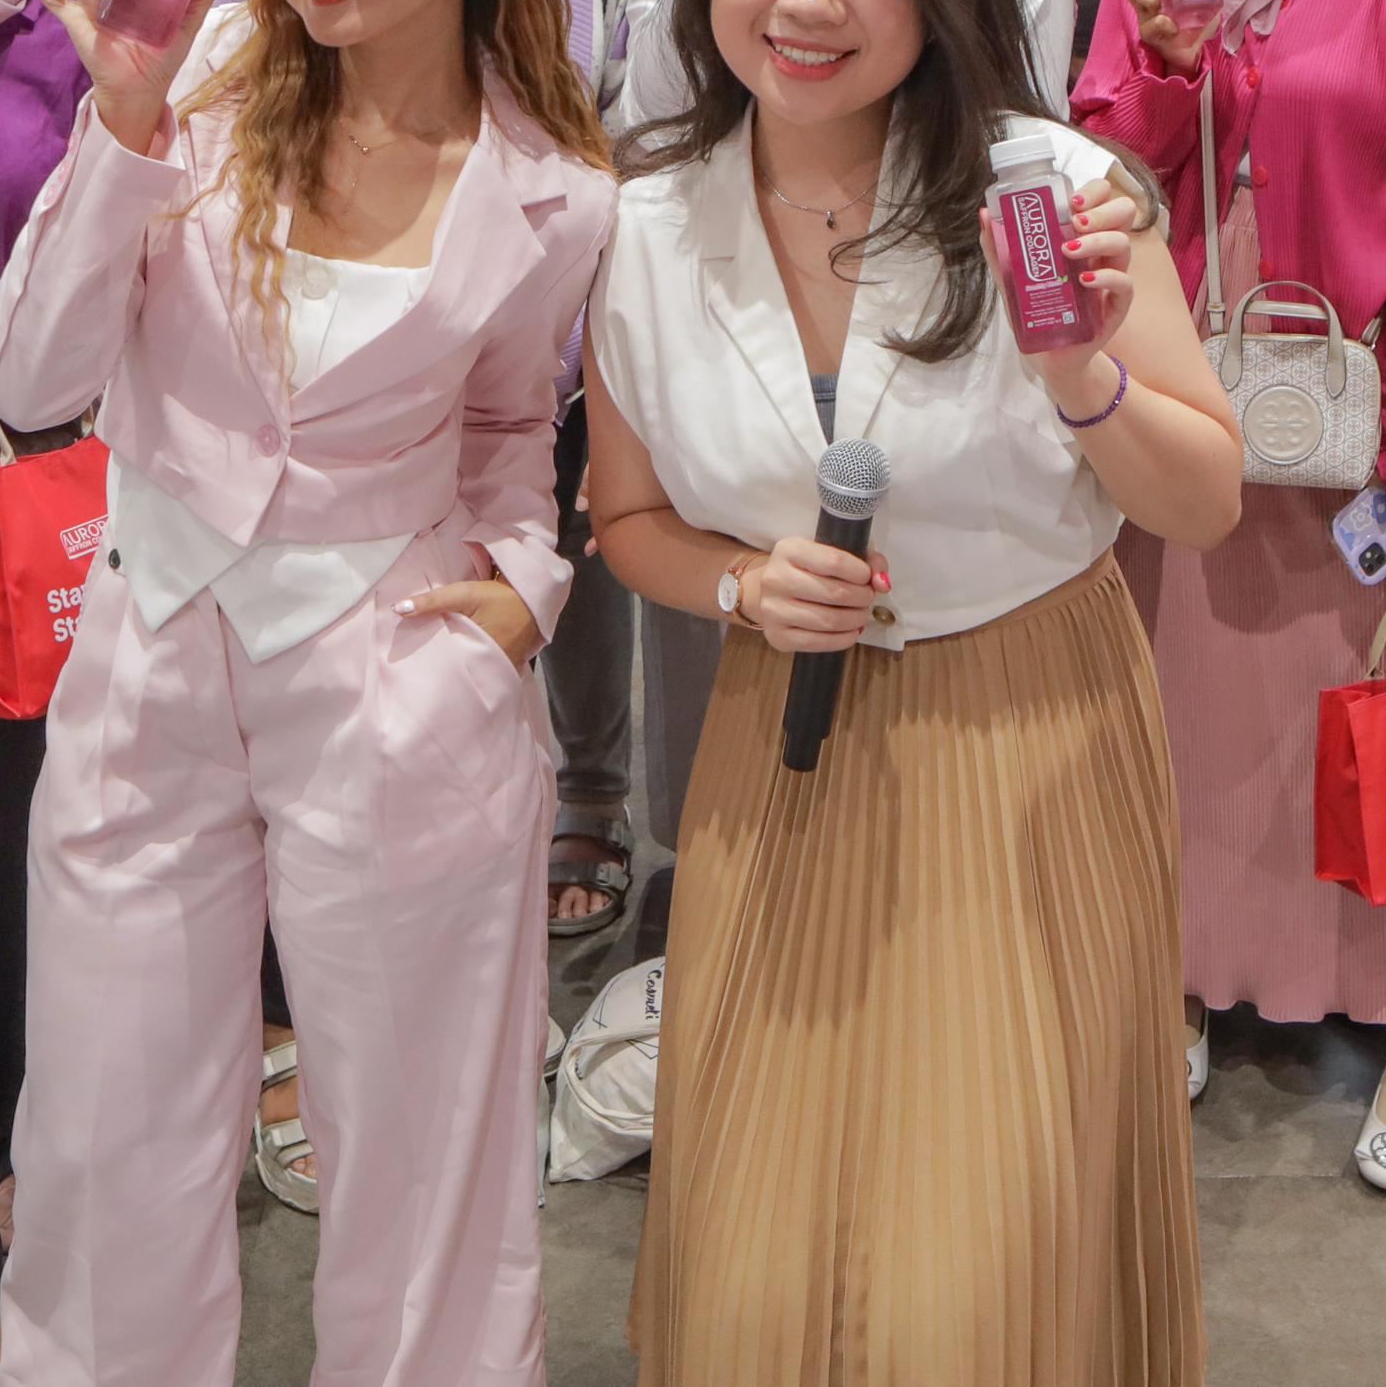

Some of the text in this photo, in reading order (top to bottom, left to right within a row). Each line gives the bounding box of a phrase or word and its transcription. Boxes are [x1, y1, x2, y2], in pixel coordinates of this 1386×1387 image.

[1017, 196, 1041, 280] SAFFRON COLLAGEN
[1023, 194, 1053, 279] AURORA
